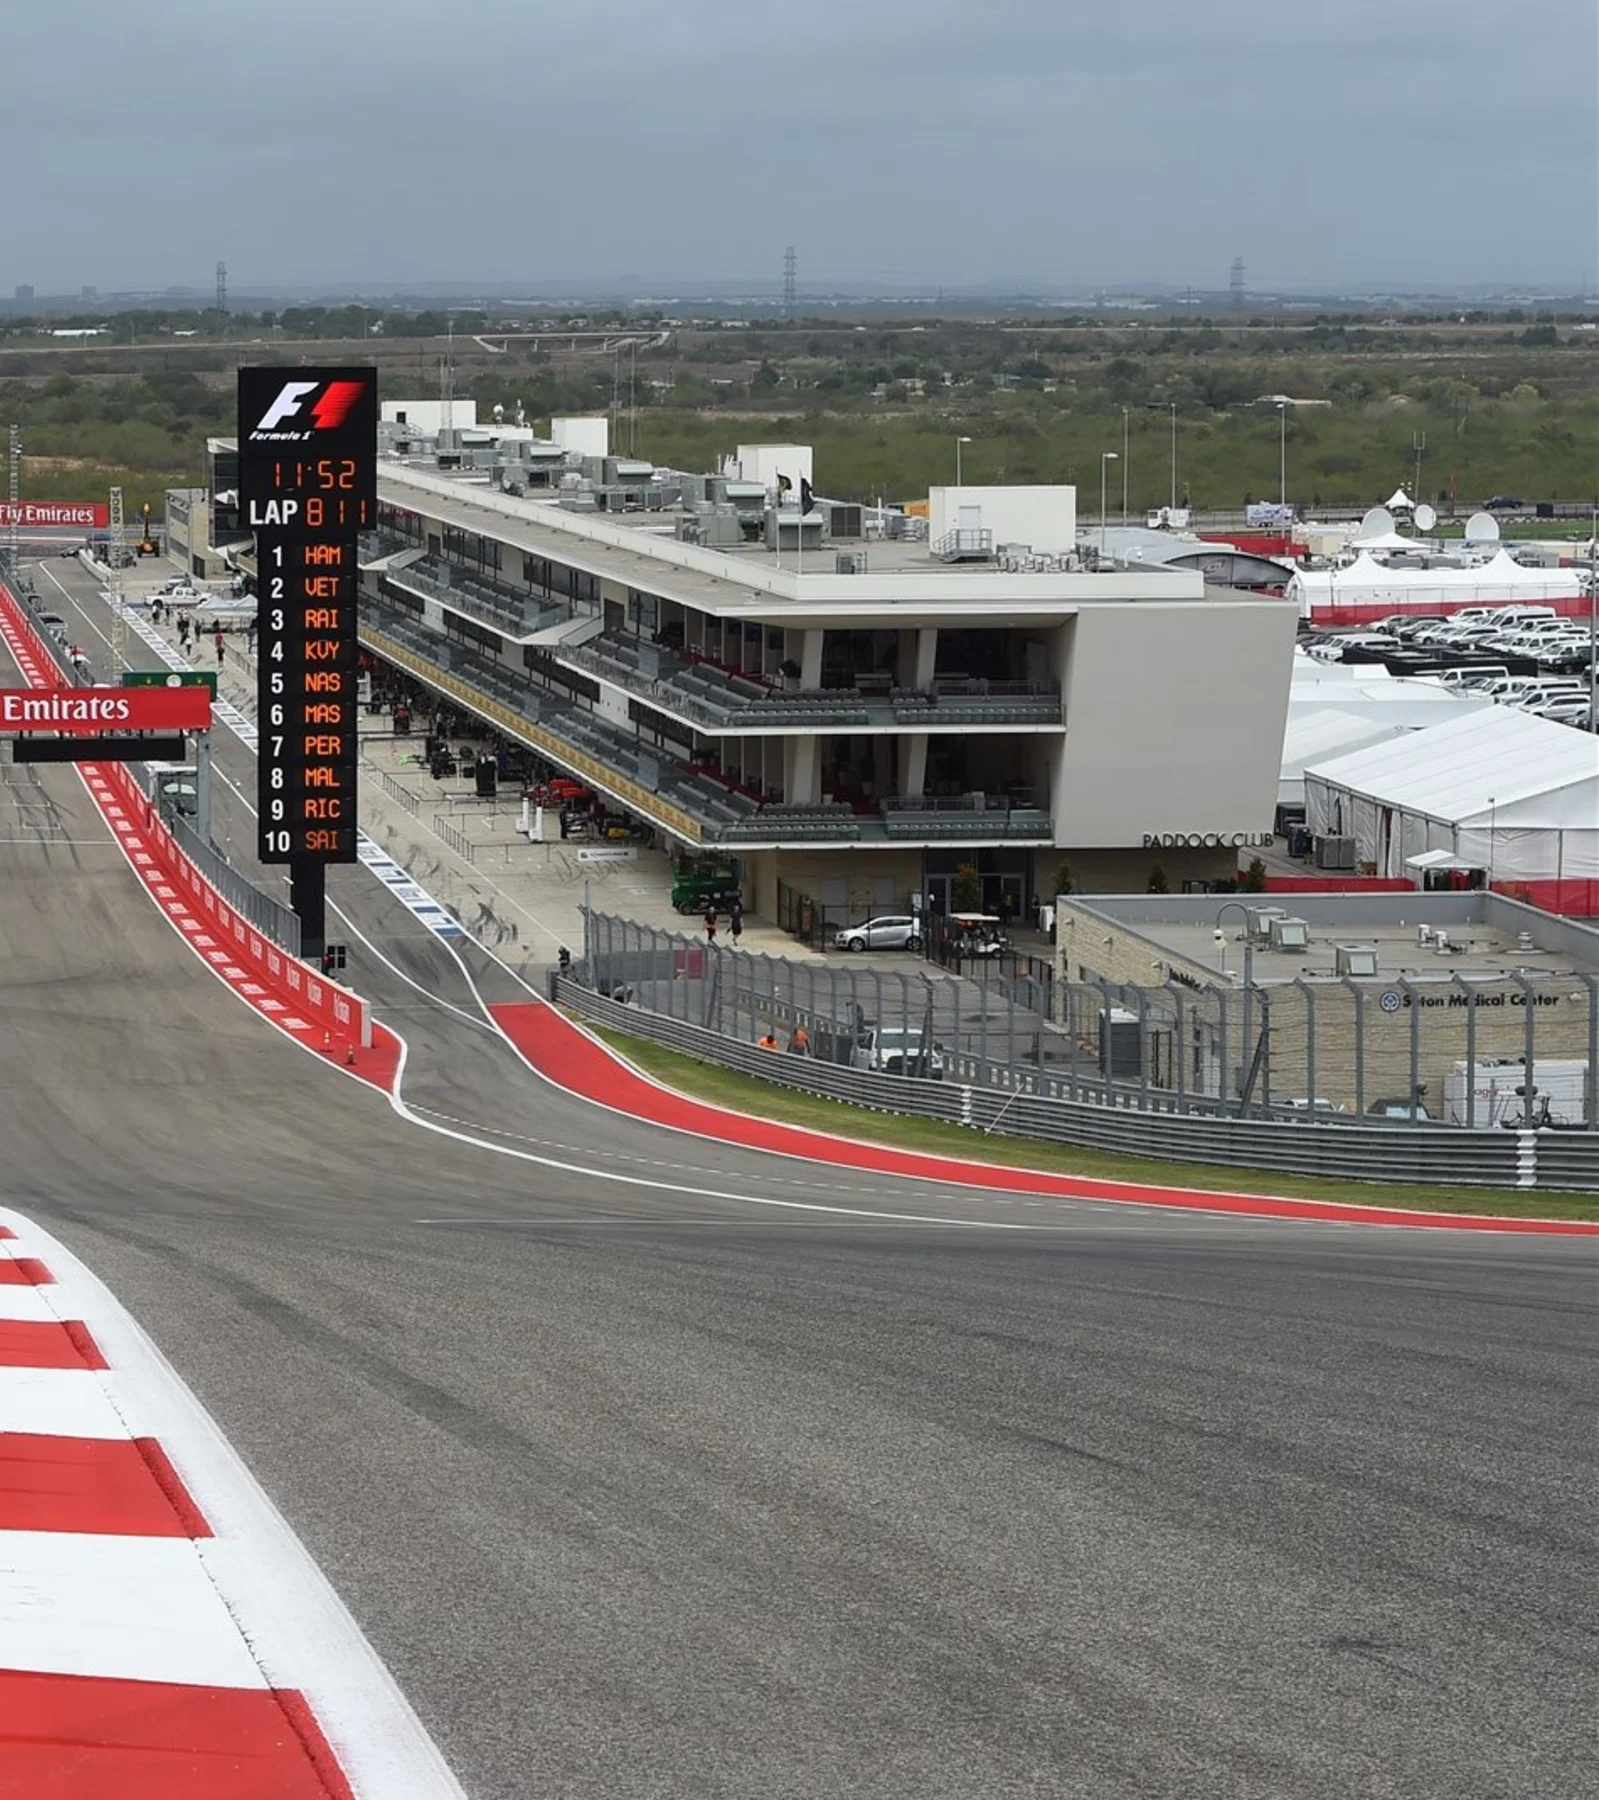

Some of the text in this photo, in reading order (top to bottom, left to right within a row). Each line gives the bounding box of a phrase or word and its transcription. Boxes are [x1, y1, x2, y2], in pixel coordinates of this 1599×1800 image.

[249, 431, 301, 441] Formula
[26, 504, 93, 523] Emirates
[250, 499, 298, 525] LAP
[273, 545, 340, 566] 1 HAM
[271, 577, 338, 598] 2 VET
[271, 609, 337, 630] 3 RAI
[271, 641, 339, 661] 4 KVY
[272, 672, 340, 693] 5 NAS
[3, 694, 130, 721] Emirates
[271, 704, 340, 725] 6 MAS
[271, 736, 340, 756] 7 PER
[271, 767, 340, 788] 8 MAL
[272, 799, 340, 820] 9 RIC
[265, 830, 336, 852] 10 SAI
[1143, 832, 1274, 848] PADDOCK CLUB
[1403, 994, 1444, 1007] Ston
